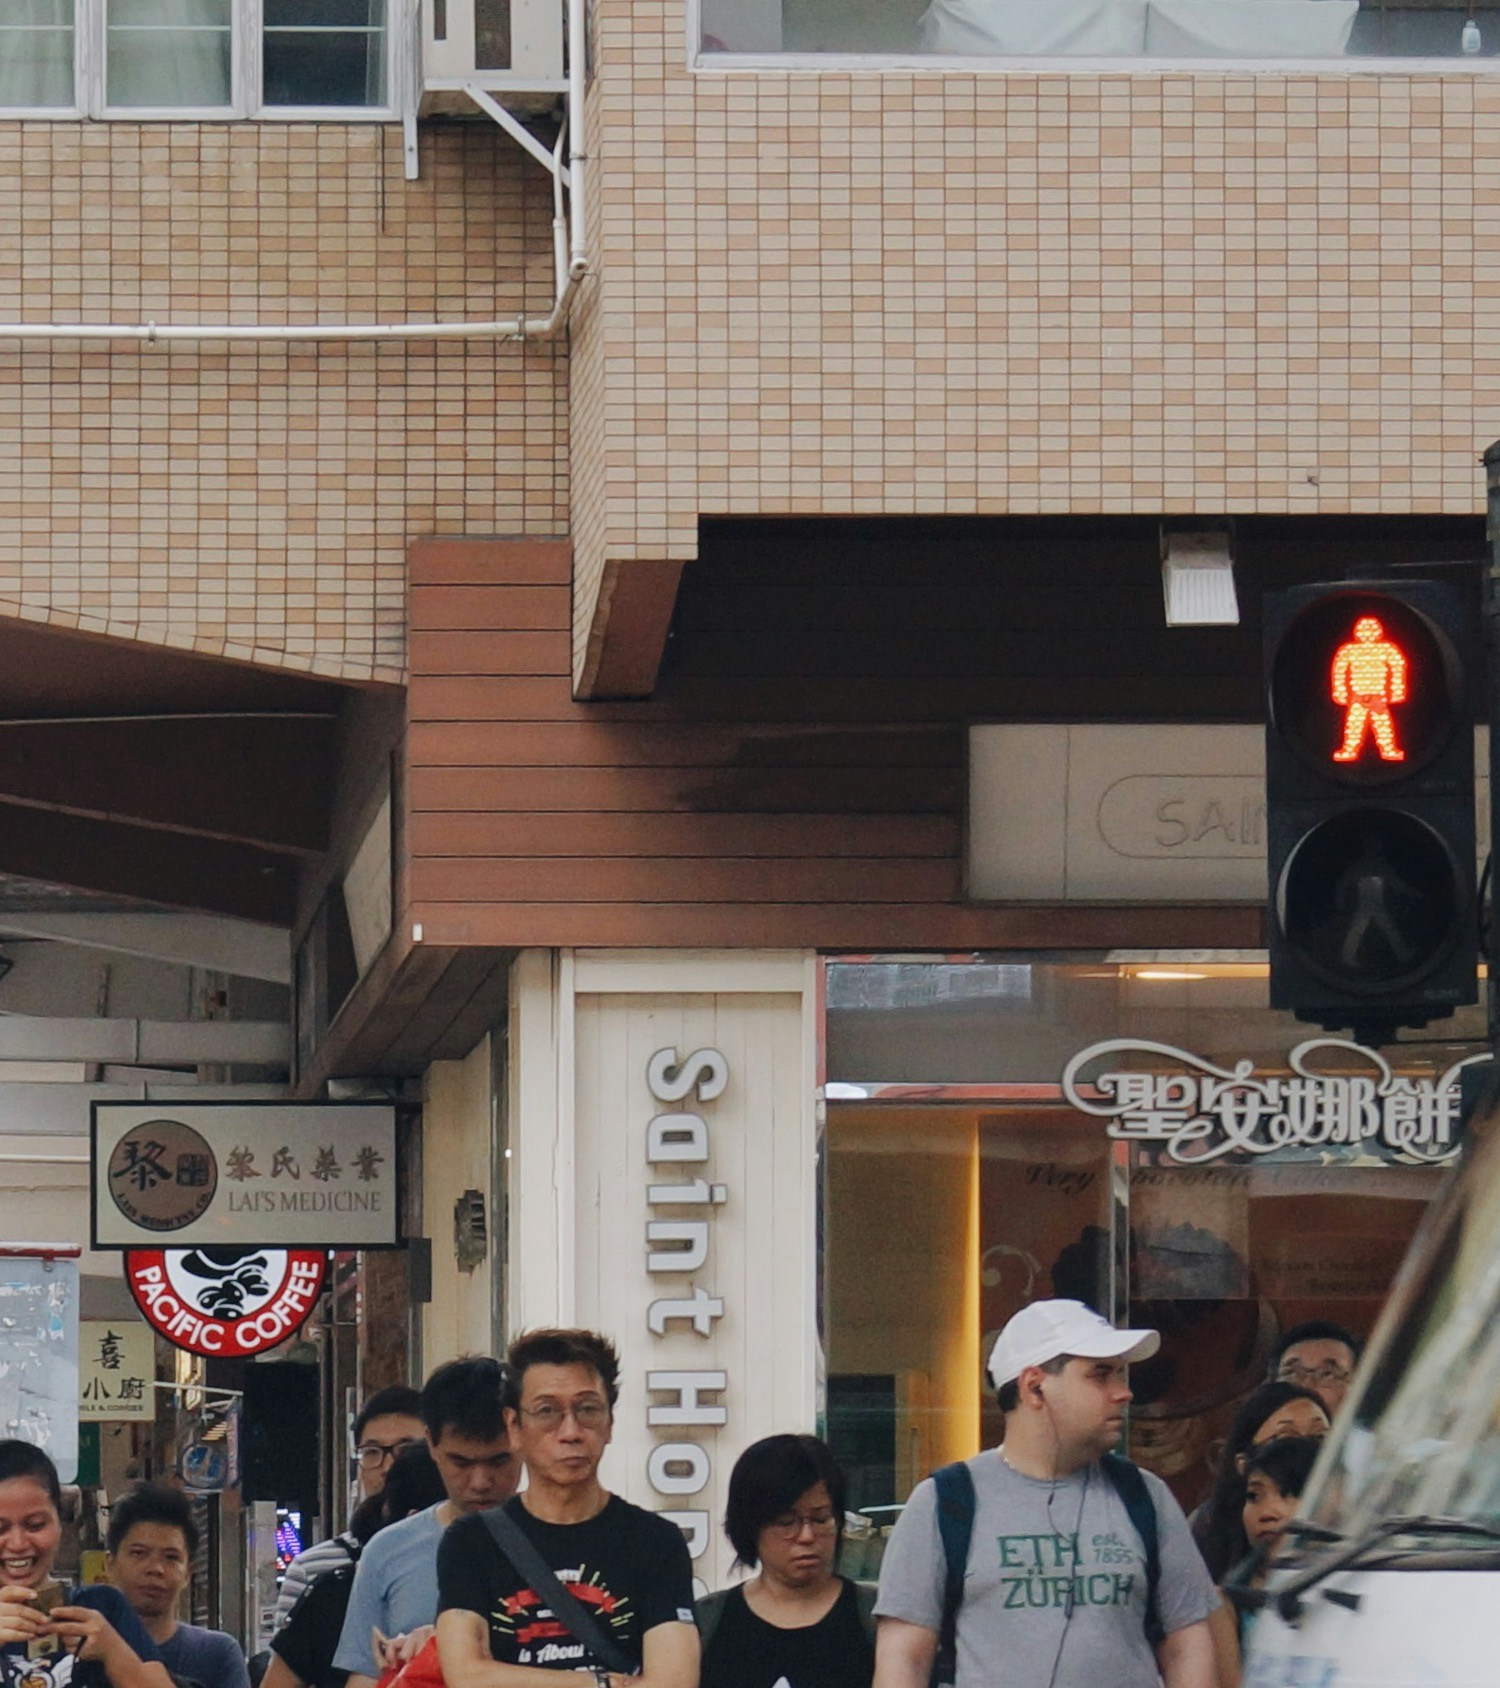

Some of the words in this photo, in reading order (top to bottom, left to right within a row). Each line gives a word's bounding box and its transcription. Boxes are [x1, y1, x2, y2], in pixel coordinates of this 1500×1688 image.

[1155, 800, 1263, 846] SAI
[281, 1191, 382, 1212] MEDICINE
[647, 1047, 728, 1337] Saint
[135, 1265, 225, 1350] PACIFIC
[235, 1260, 319, 1348] COFFEE
[998, 1533, 1083, 1568] ETH
[1001, 1568, 1136, 1609] ZÜRICH
